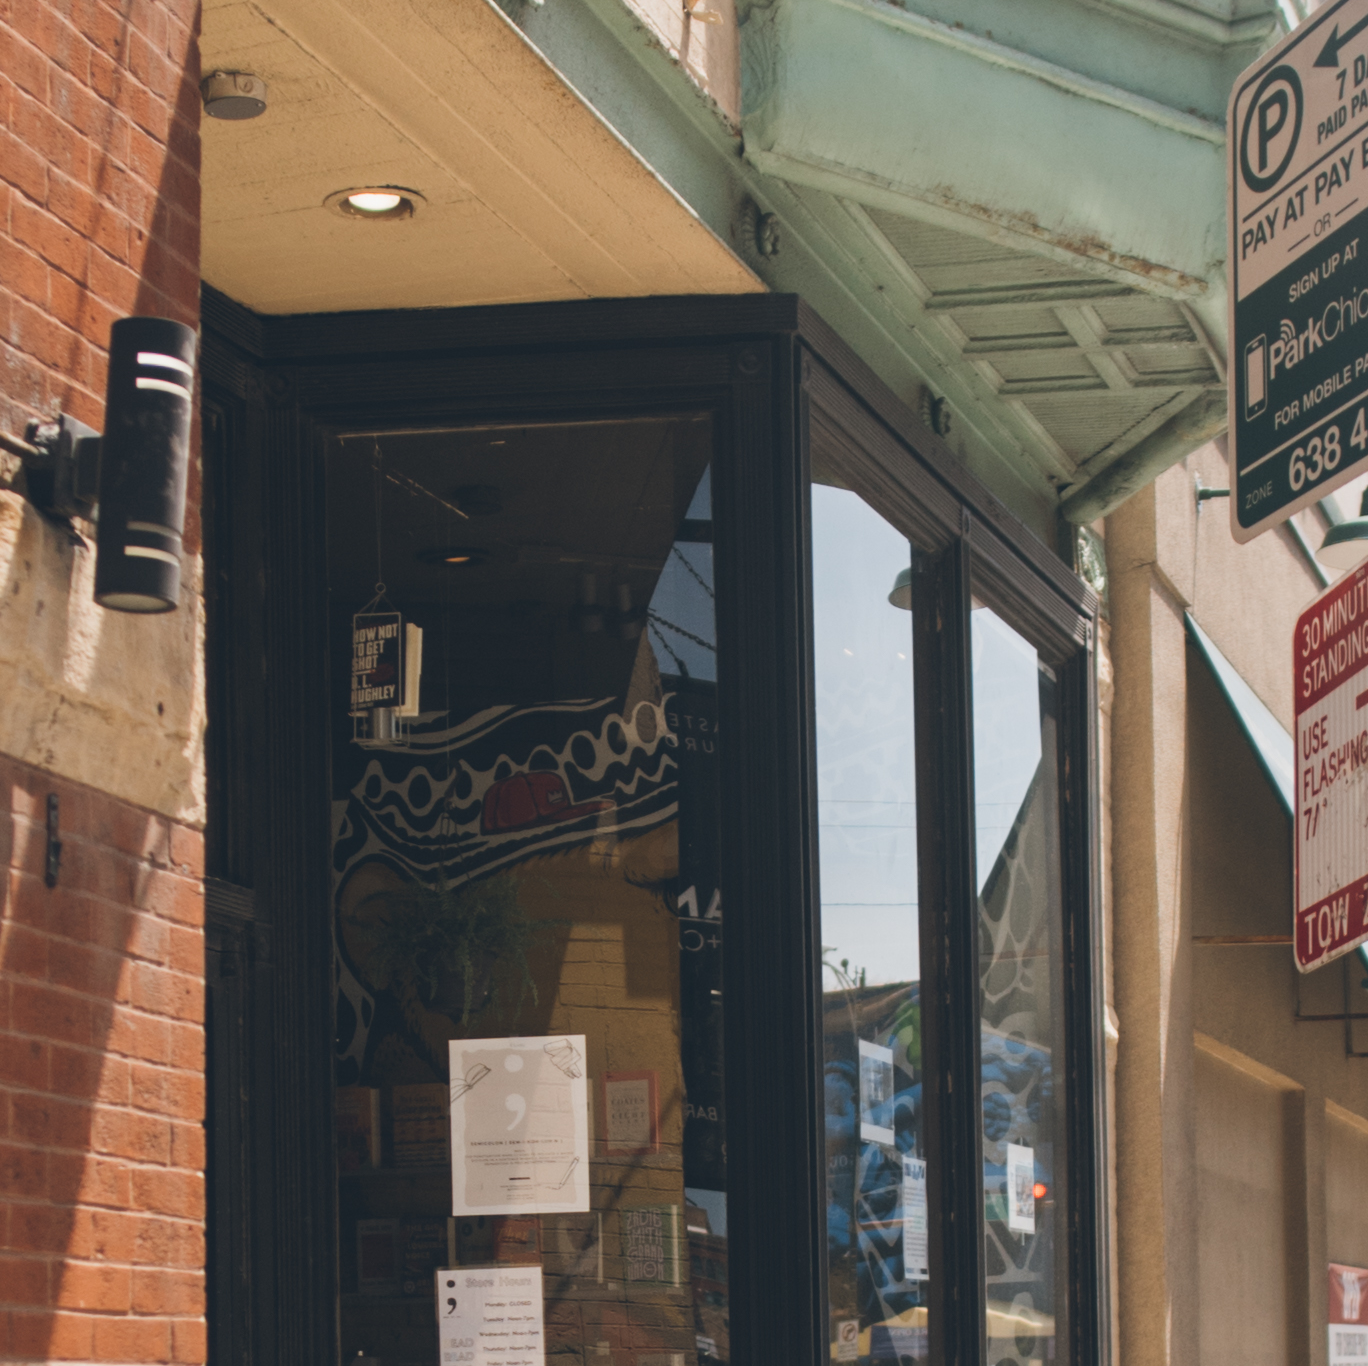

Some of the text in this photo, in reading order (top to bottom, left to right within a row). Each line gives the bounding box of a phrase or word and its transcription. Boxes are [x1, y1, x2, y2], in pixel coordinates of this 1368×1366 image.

[1317, 104, 1347, 145] PAID
[1241, 206, 1279, 261] PAY
[1283, 183, 1309, 231] AT
[1315, 148, 1355, 206] PAY
[1313, 212, 1331, 238] OR
[1288, 238, 1359, 303] SIGN UP AT
[1274, 400, 1300, 430] FOR
[1303, 365, 1352, 412] MOBILE
[1245, 481, 1273, 510] ZONE
[1288, 425, 1341, 492] 638
[378, 623, 399, 640] NOT
[1302, 576, 1368, 657] 30 MINUT
[366, 640, 385, 655] GET
[1303, 715, 1329, 761] USE
[1304, 892, 1350, 955] TOW
[465, 1276, 532, 1288] Store Hours
